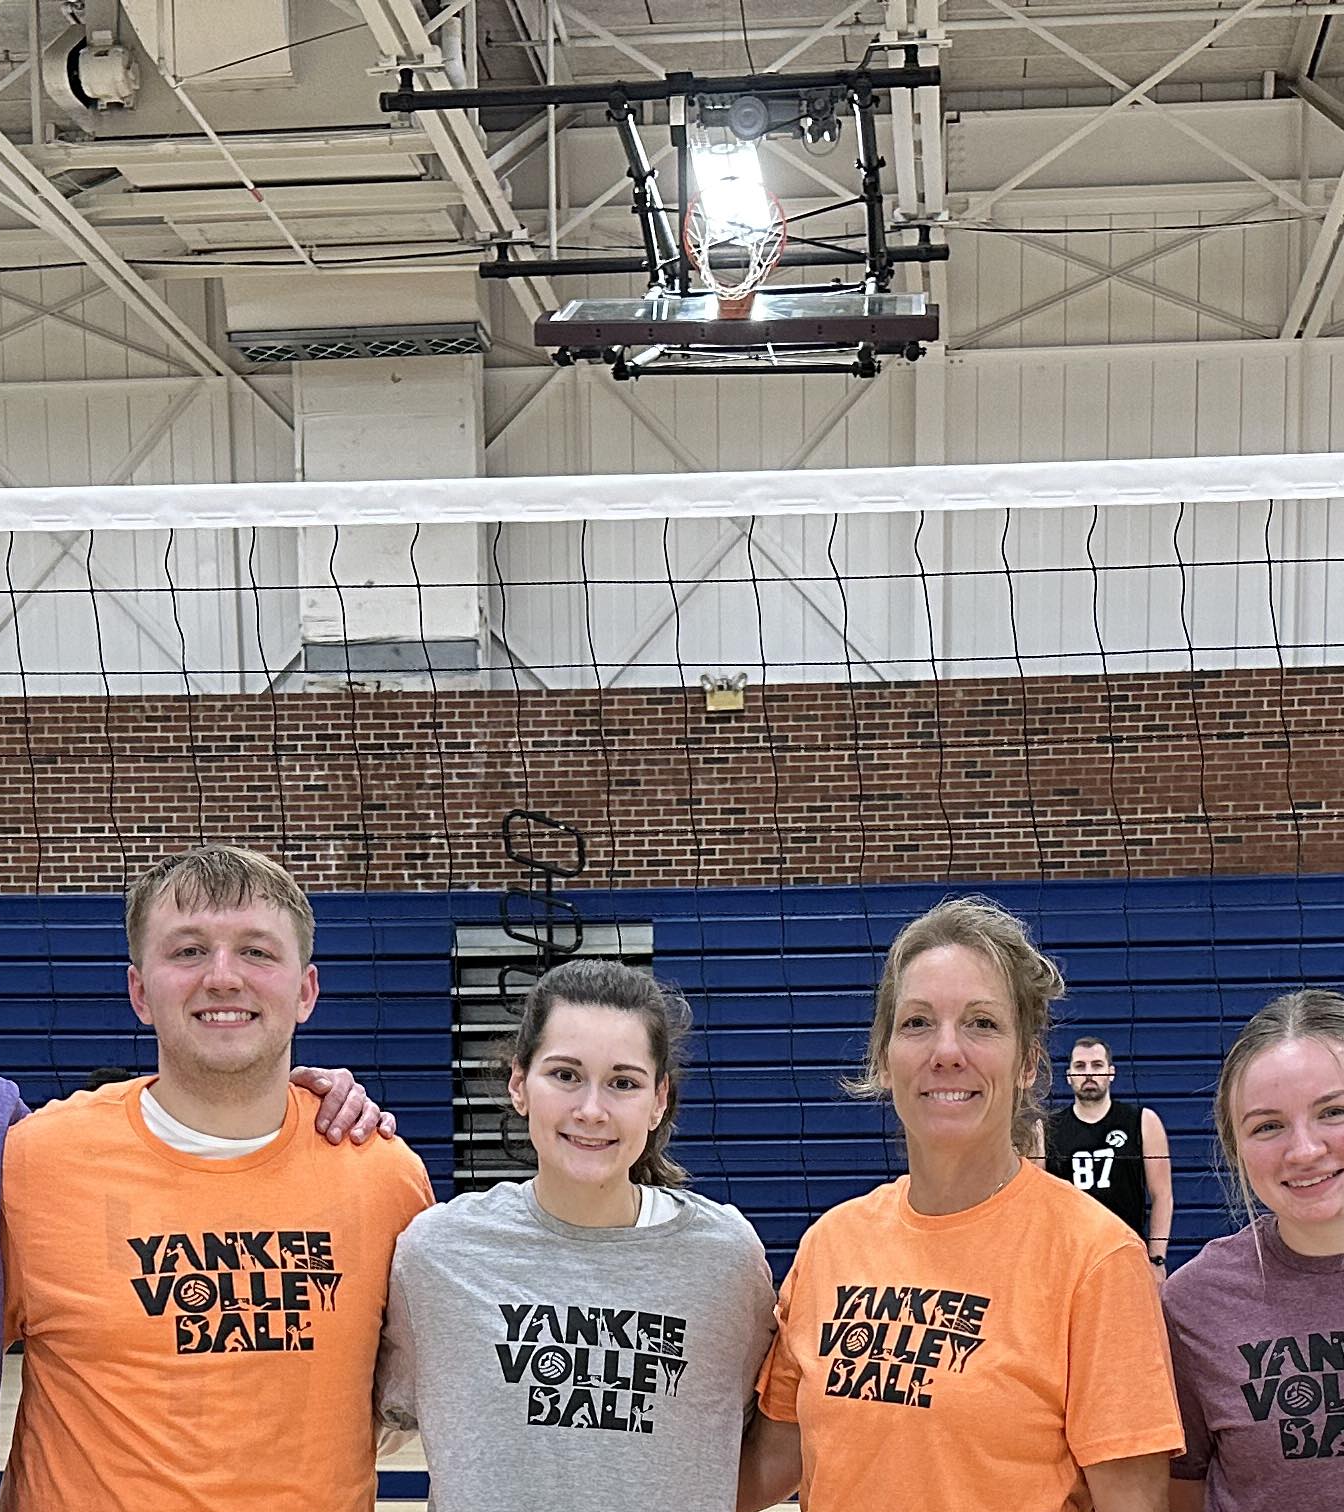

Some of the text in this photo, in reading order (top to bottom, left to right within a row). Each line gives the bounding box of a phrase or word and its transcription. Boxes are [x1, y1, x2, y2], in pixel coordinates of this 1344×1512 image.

[1072, 1148, 1114, 1190] 87
[127, 1231, 334, 1275] YANKEE
[130, 1272, 343, 1316] VOLLEY
[833, 1286, 991, 1335] YANKEE
[176, 1312, 314, 1355] BALL
[498, 1304, 686, 1357] YANKEE
[819, 1321, 986, 1373] VOLLEY
[495, 1343, 688, 1397] VOLLEY
[825, 1358, 934, 1408] BALL
[527, 1386, 654, 1434] BALL
